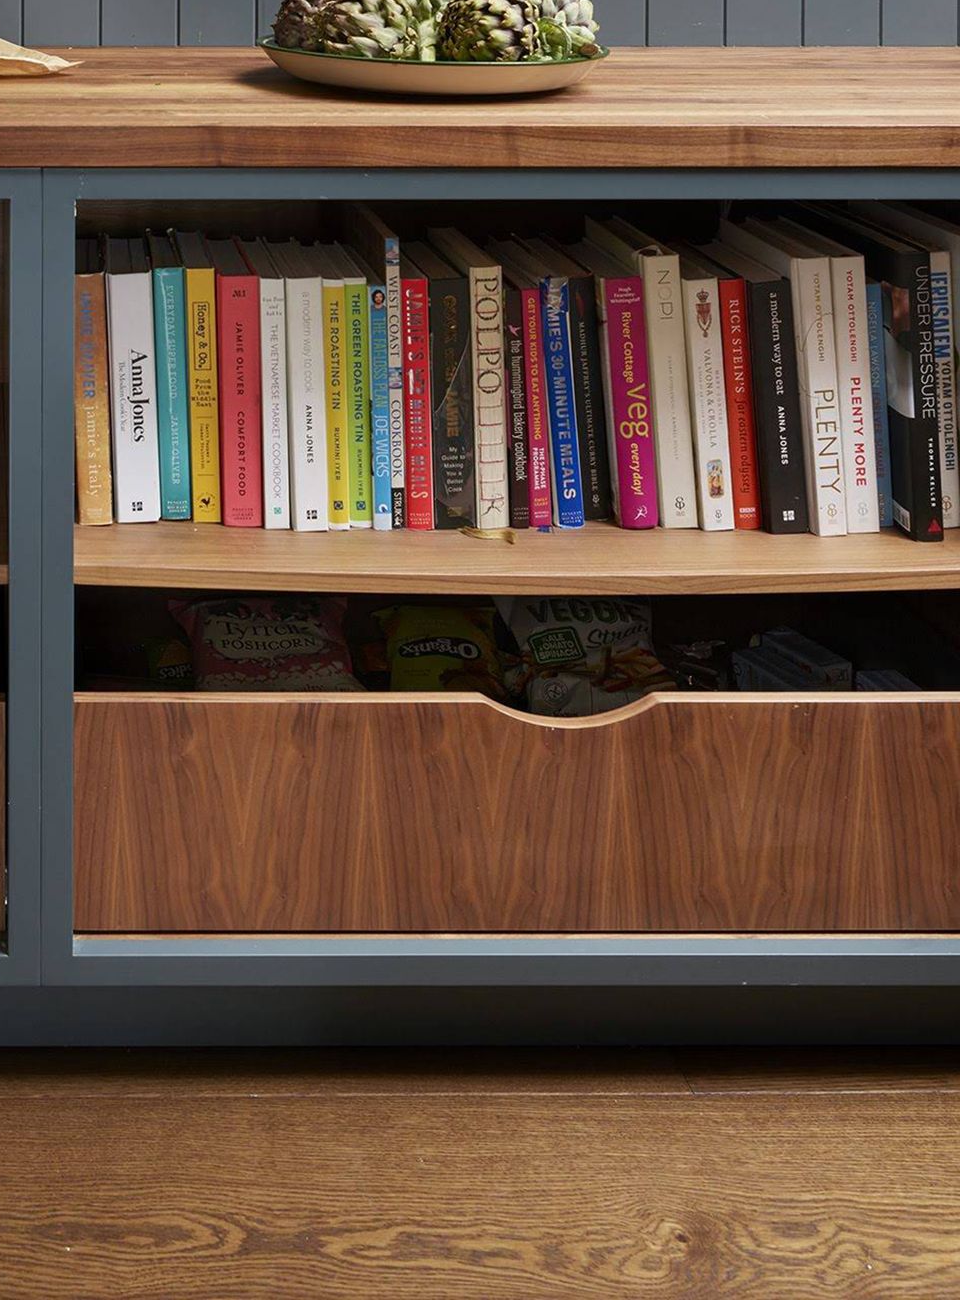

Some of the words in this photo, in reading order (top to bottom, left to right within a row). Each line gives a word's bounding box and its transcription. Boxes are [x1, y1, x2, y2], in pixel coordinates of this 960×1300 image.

[389, 275, 400, 313] WEST
[657, 269, 673, 320] NOPI
[813, 273, 821, 302] YOTAM
[846, 269, 855, 301] YOTAM
[915, 266, 931, 325] UNDER
[195, 304, 207, 338] Honey
[302, 299, 314, 336] modern
[330, 301, 339, 323] THE
[352, 293, 361, 316] THE
[528, 297, 536, 313] GET
[729, 299, 741, 334] RICK
[769, 300, 781, 341] modern
[235, 321, 244, 353] JAMIE
[270, 324, 279, 343] THE
[352, 318, 362, 358] GREEN
[390, 314, 400, 358] COAST
[474, 274, 502, 394] POLPO
[528, 314, 537, 340] YOUR
[578, 321, 587, 356] MADHUR
[621, 311, 633, 339] River
[815, 304, 824, 362] OTTOLENGHI
[848, 303, 857, 362] OTTOLENGHI
[198, 341, 208, 349] &
[198, 352, 208, 368] Co.
[301, 337, 311, 357] way
[304, 358, 312, 368] to
[330, 326, 340, 387] ROASTING
[510, 340, 522, 354] the
[529, 341, 538, 362] KIDS
[622, 341, 635, 384] Cottage
[770, 343, 782, 365] way
[130, 349, 148, 397] Anna
[236, 356, 245, 396] OLIVER
[270, 343, 280, 399] VIETNAMESE
[304, 370, 314, 393] cook
[510, 355, 525, 410] hummingbird
[530, 364, 538, 376] TO
[703, 348, 716, 397] VALVONA
[731, 338, 746, 394] STEIN'S
[775, 366, 783, 377] to
[870, 344, 880, 388] LAWSON
[919, 331, 936, 419] PRESSURE
[941, 360, 952, 399] YOTAM
[332, 391, 341, 410] TIN
[353, 361, 363, 420] ROASTING
[531, 377, 539, 394] EAT
[550, 355, 571, 439] 30-MINUTE
[707, 398, 715, 406] &
[775, 378, 785, 394] eat
[127, 396, 150, 443] Jones
[271, 403, 281, 439] MARKET
[305, 404, 313, 432] ANNA
[532, 395, 541, 440] ANYTHING
[584, 399, 594, 438] ULTIMATE
[734, 398, 749, 416] far
[777, 406, 786, 432] ANNA
[850, 377, 864, 436] PLENTY
[84, 405, 101, 459] jamie's
[170, 415, 180, 443] JAMIE
[237, 411, 246, 463] COMFORT
[355, 424, 364, 443] TIN
[375, 414, 389, 437] JOE
[392, 399, 402, 478] COOKBOOK
[511, 411, 526, 440] bakery
[708, 408, 719, 448] CROLLA
[737, 417, 750, 453] eastern
[814, 389, 841, 494] PLENTY
[942, 401, 955, 471] OTTOLENGHI
[171, 445, 181, 485] OLIVER
[306, 433, 314, 464] JONES
[376, 438, 390, 478] WICKS
[514, 442, 528, 481] cookbook
[588, 439, 596, 467] CURRY
[779, 435, 789, 465] JONES
[854, 443, 867, 487] MORE
[86, 463, 102, 498] italy
[238, 466, 247, 497] FOOD
[272, 442, 282, 499] COOKBOOK
[532, 447, 540, 490] PROGRAMME
[559, 444, 576, 499] MEALS
[590, 468, 598, 491] BIBLE
[738, 455, 752, 494] odyssey
[221, 637, 317, 651] POSHCORN
[400, 637, 481, 658] Organix
